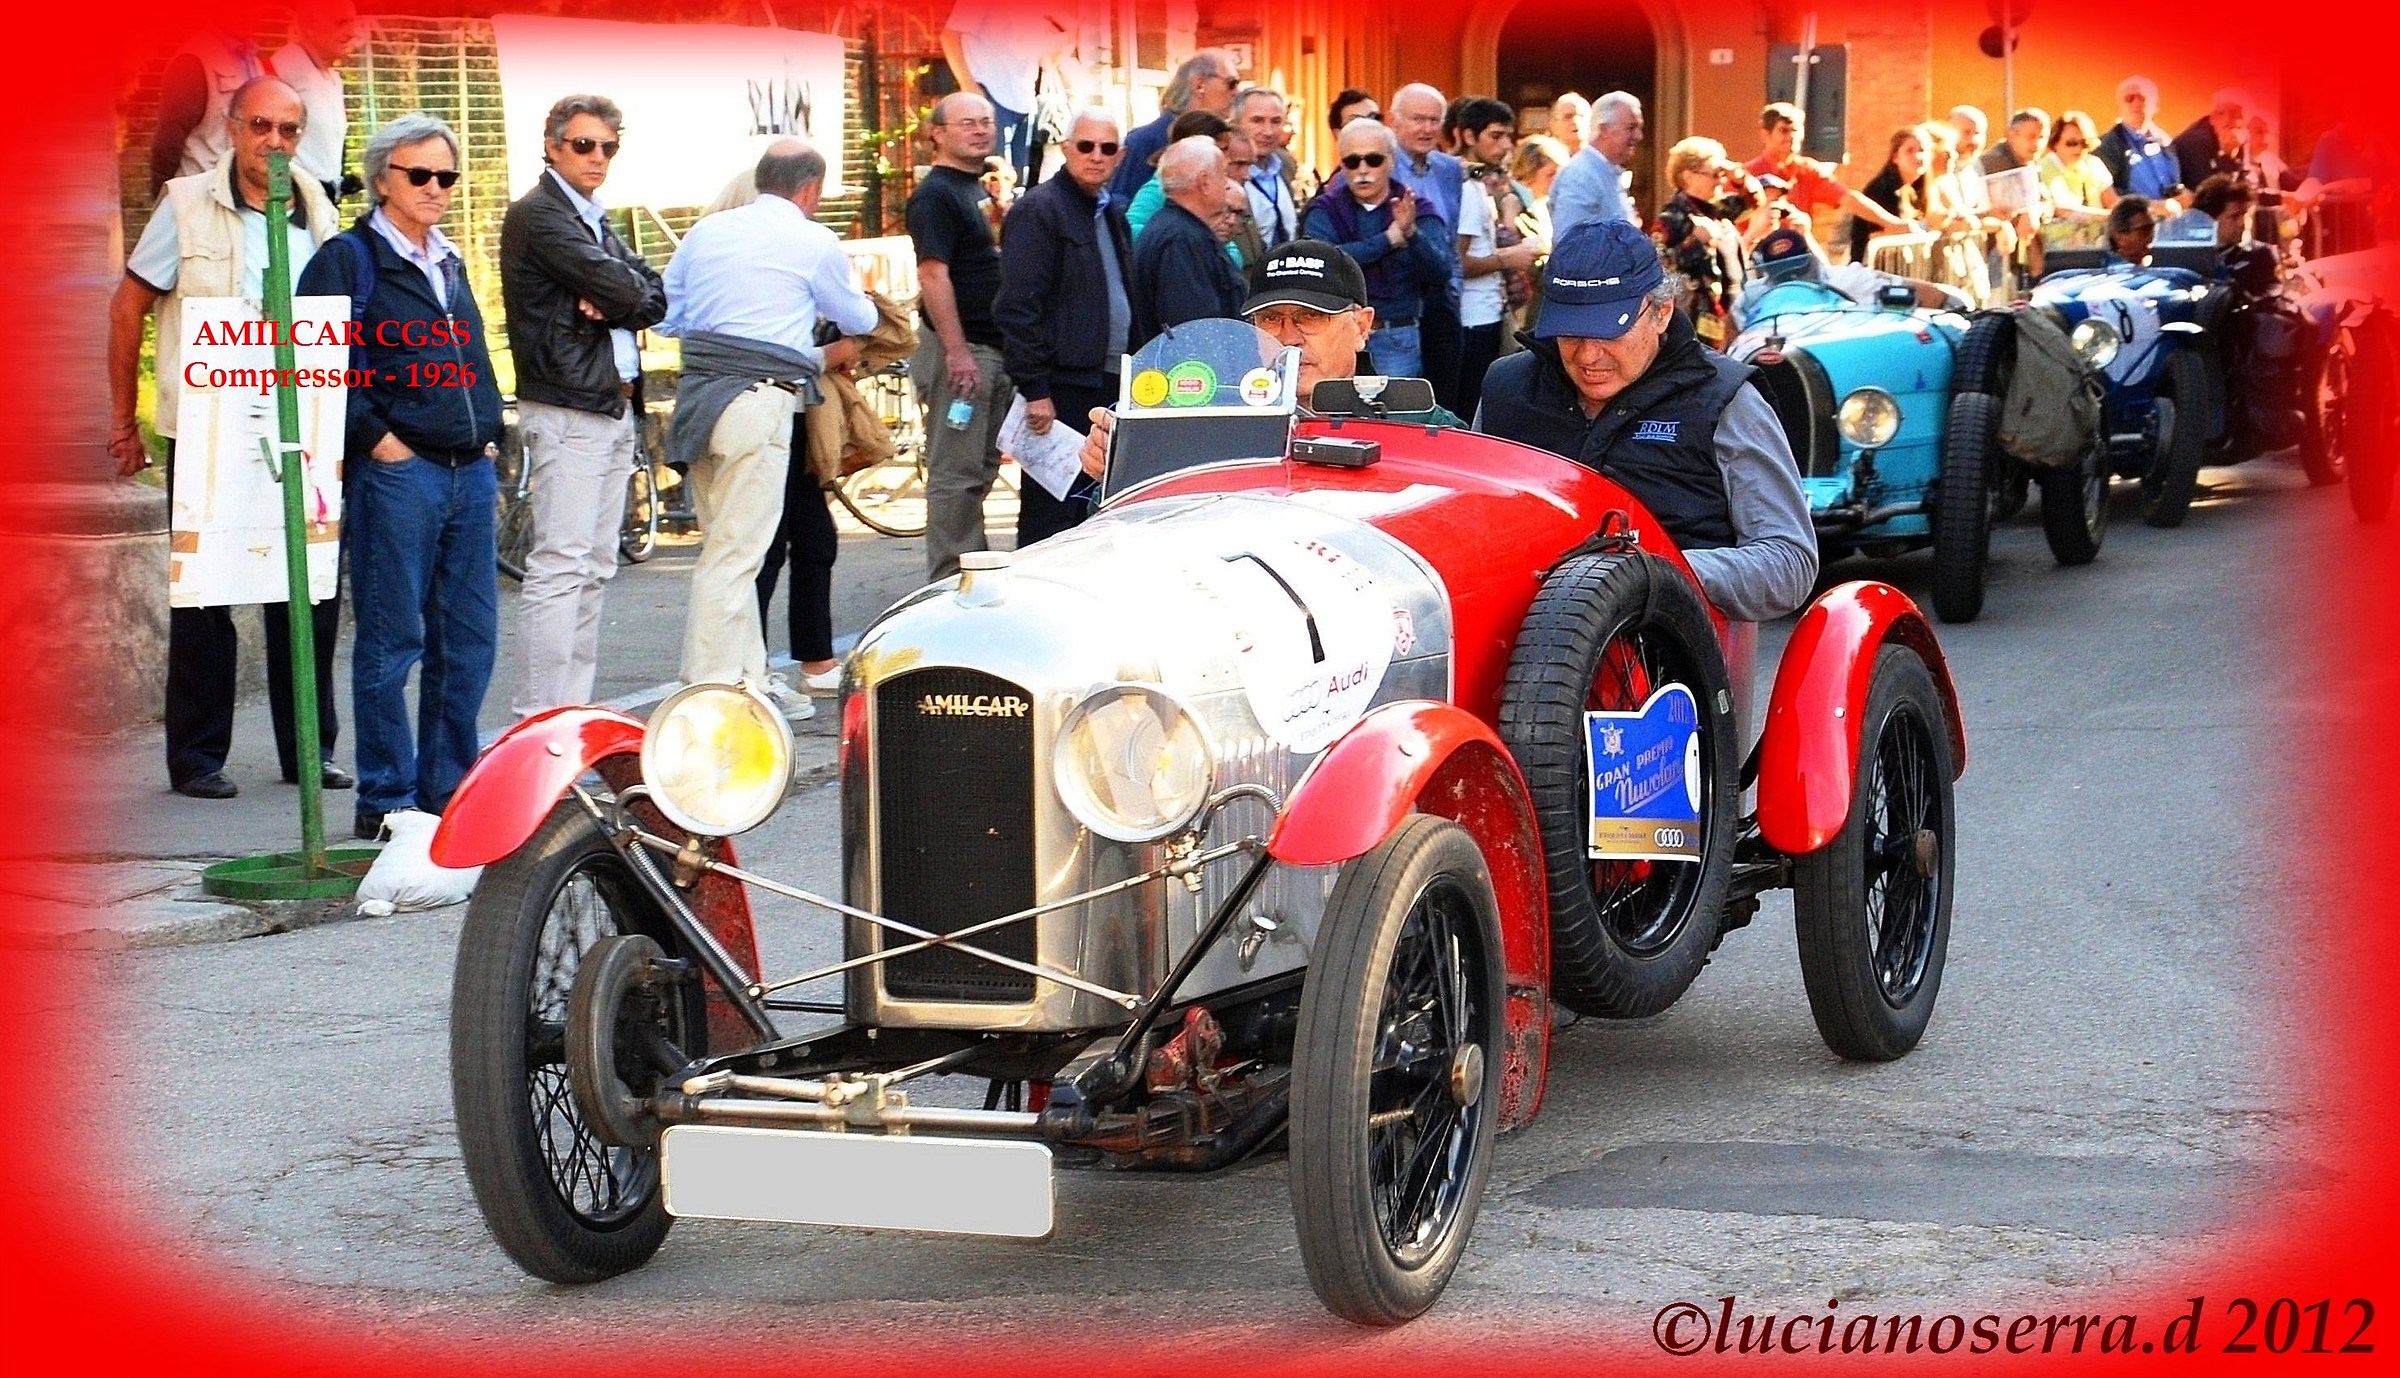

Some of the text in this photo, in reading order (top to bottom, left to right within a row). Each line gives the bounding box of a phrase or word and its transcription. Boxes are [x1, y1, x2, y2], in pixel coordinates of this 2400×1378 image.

[1552, 276, 1621, 288] PORSCHE
[1327, 661, 1369, 698] Audi
[1596, 761, 1630, 790] GRAN
